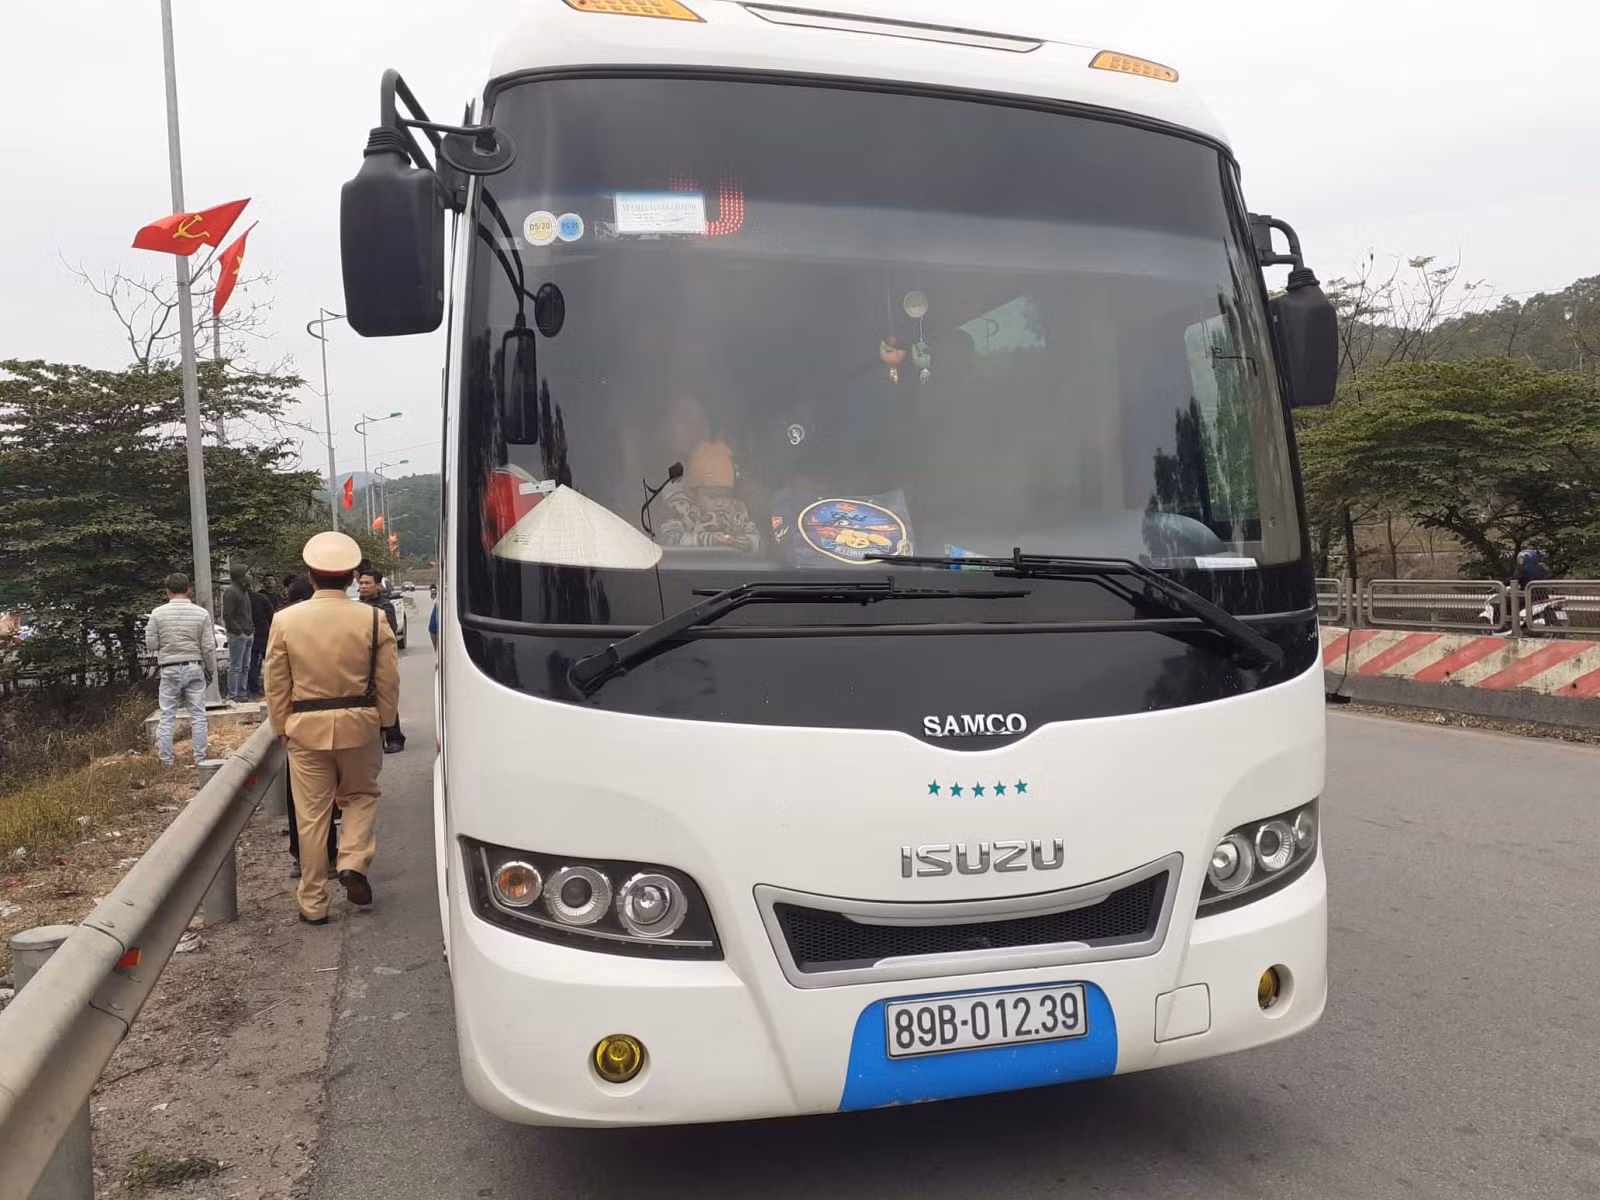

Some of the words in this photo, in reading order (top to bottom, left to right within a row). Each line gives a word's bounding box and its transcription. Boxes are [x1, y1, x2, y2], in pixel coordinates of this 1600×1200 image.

[530, 221, 550, 231] 05/20
[923, 713, 1027, 736] SAMCO
[901, 838, 1065, 879] ISUZU
[894, 991, 1079, 1050] 89B-012.39
